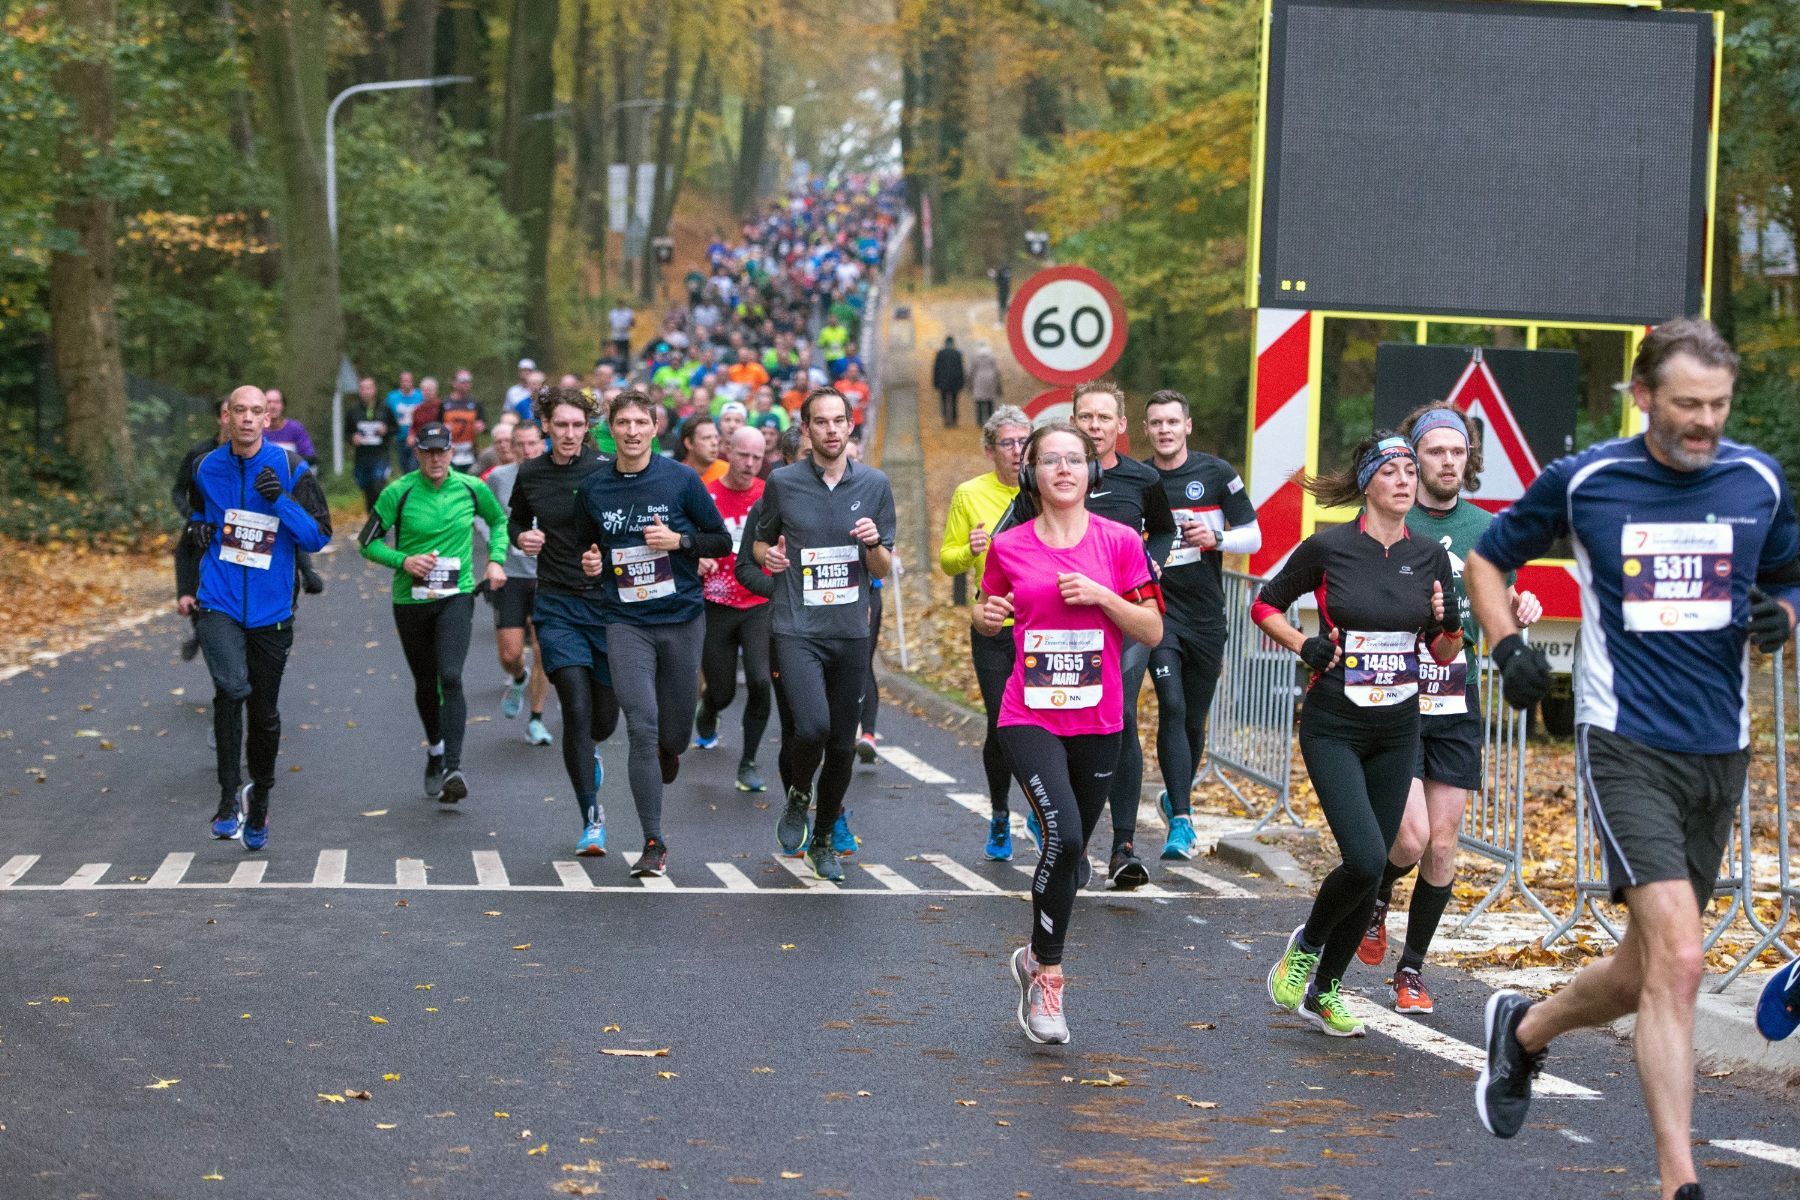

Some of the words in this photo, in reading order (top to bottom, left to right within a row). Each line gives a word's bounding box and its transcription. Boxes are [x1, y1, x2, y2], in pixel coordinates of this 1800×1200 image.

[1032, 306, 1104, 348] 60
[647, 504, 669, 513] Boels
[234, 526, 264, 543] 6360
[1635, 531, 1648, 548] 7
[616, 552, 624, 562] 7
[808, 552, 817, 561] 7
[627, 561, 656, 577] 5567
[815, 563, 849, 579] 14155
[1653, 555, 1703, 580] 5311
[633, 574, 656, 587] ARJAN
[817, 577, 849, 589] MAARTEN
[1032, 635, 1043, 648] 7
[1355, 636, 1366, 648] 7
[1045, 653, 1084, 671] 7655
[1362, 654, 1407, 671] 14498
[1051, 672, 1080, 686] MARIJ
[1375, 673, 1396, 684] ILSE
[1419, 664, 1451, 680] 6511
[1427, 682, 1439, 693] LO
[1030, 774, 1062, 894] www.hortilux.com
